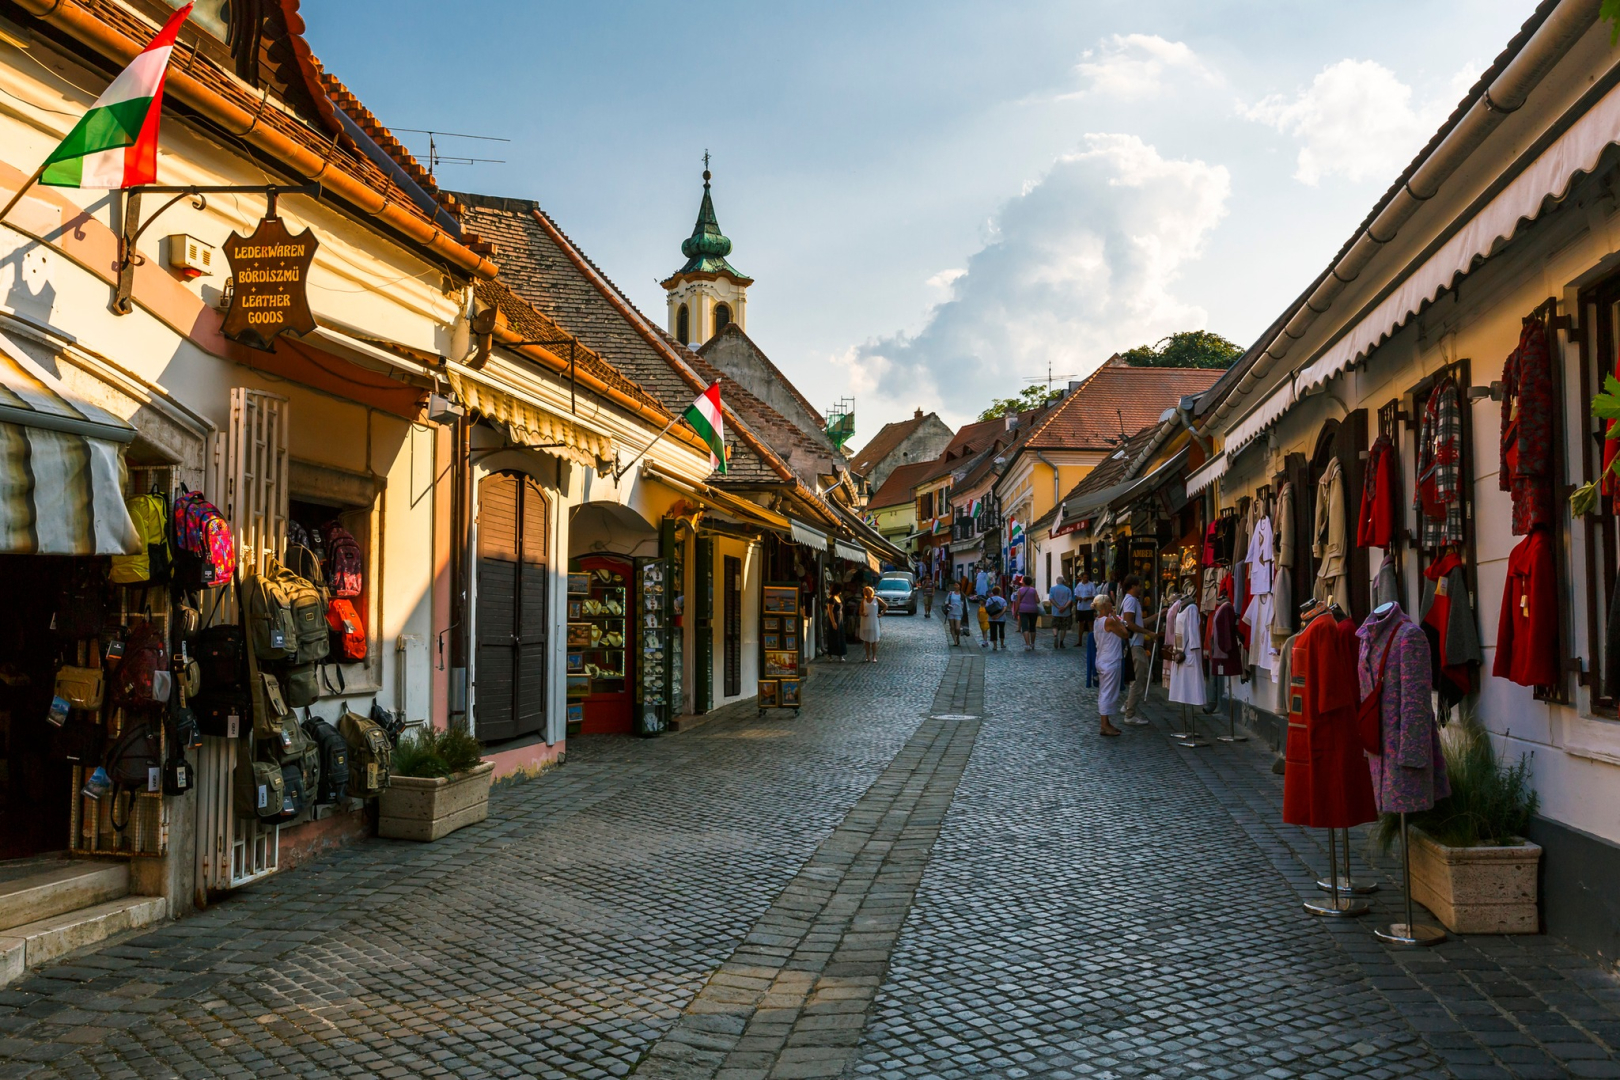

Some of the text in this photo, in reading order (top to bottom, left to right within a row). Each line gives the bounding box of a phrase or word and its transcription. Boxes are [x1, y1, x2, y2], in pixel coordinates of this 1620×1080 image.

[234, 244, 305, 259] LEDERWAREN
[242, 294, 291, 308] LEATHER
[248, 311, 284, 324] GOODS
[1132, 549, 1153, 558] AMBER
